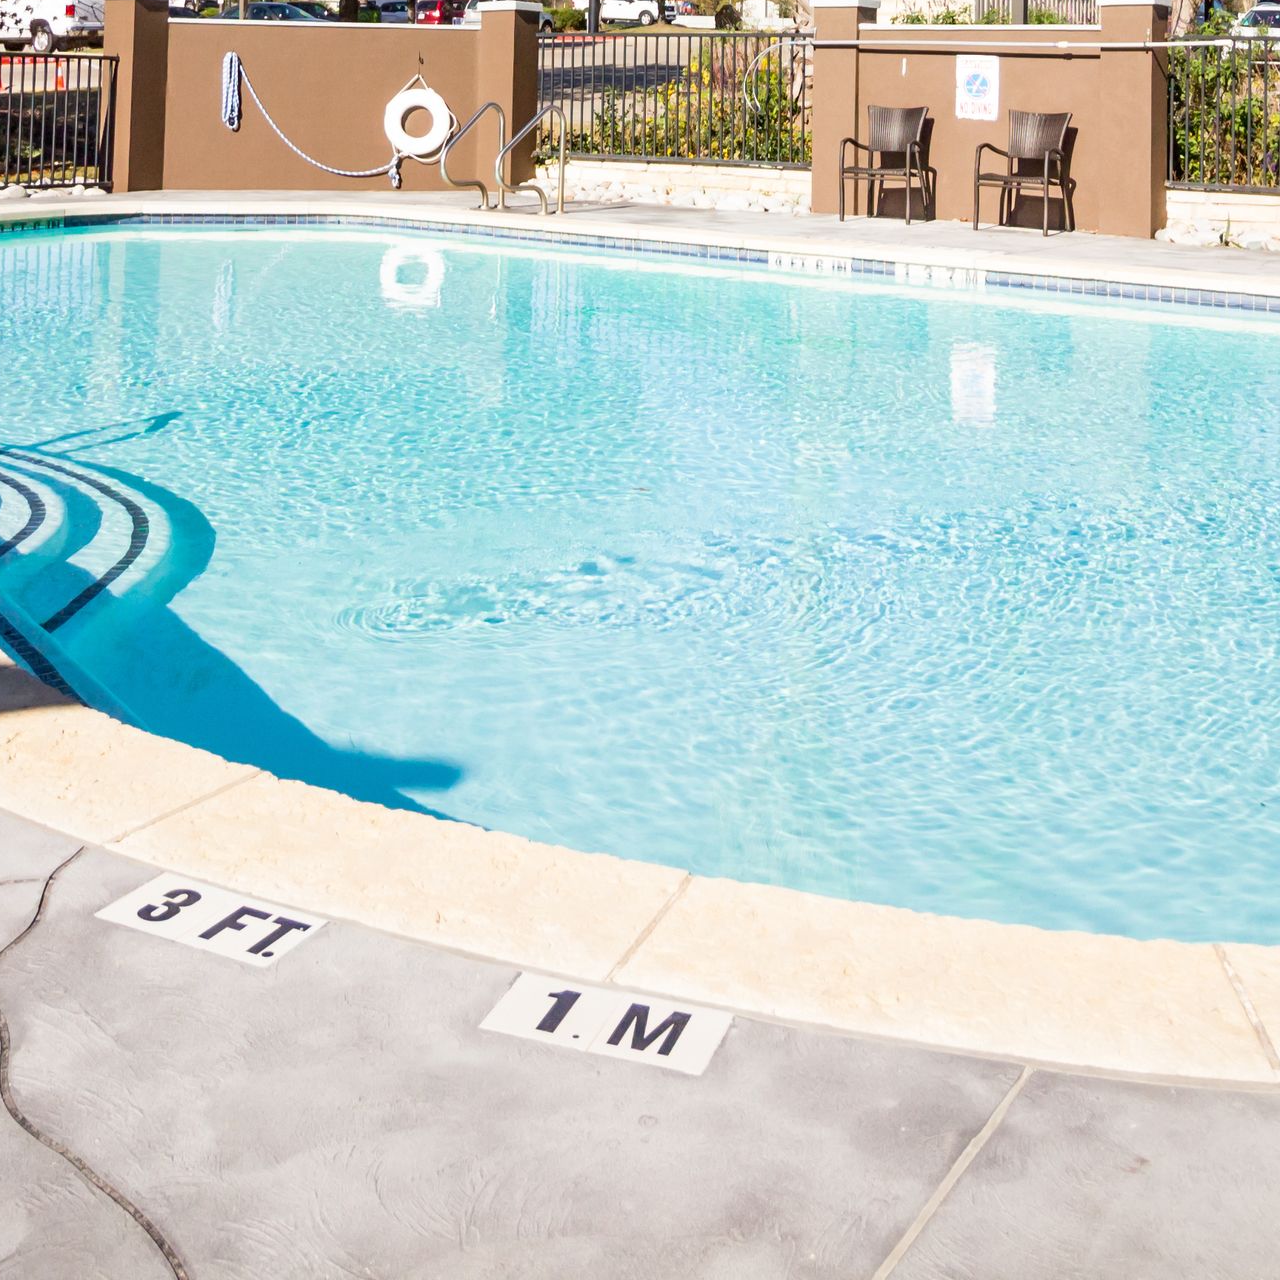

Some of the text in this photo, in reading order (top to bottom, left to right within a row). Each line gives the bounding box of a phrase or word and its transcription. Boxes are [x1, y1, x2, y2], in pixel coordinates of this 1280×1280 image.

[137, 888, 313, 958] 3 FT.
[606, 1002, 693, 1057] M
